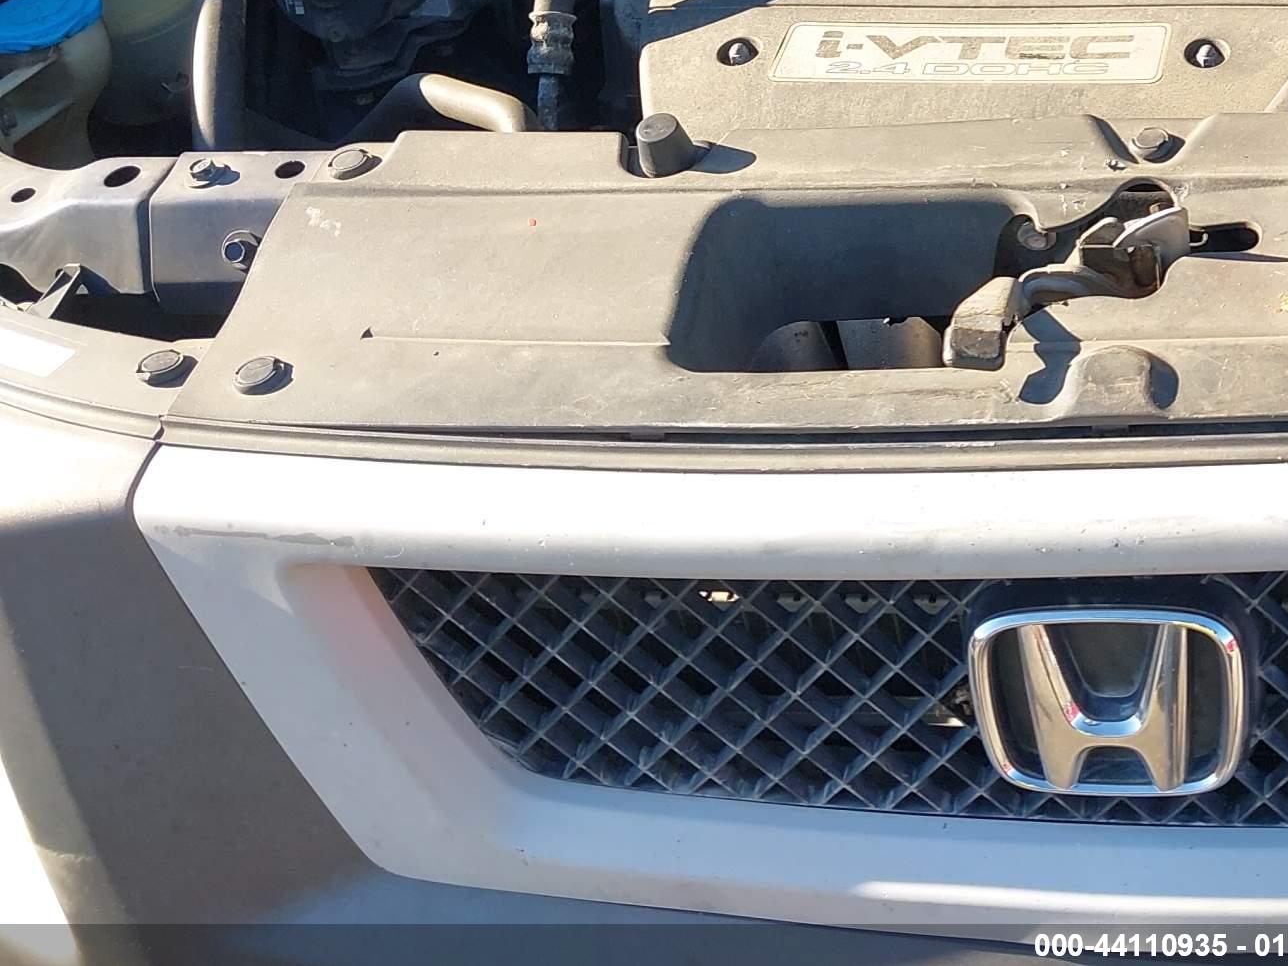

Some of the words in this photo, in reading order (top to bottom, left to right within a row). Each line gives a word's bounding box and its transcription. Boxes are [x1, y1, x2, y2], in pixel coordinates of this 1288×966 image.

[815, 30, 1135, 60] i-VTEC
[825, 61, 911, 75] 2.4
[921, 61, 1109, 76] DOHC
